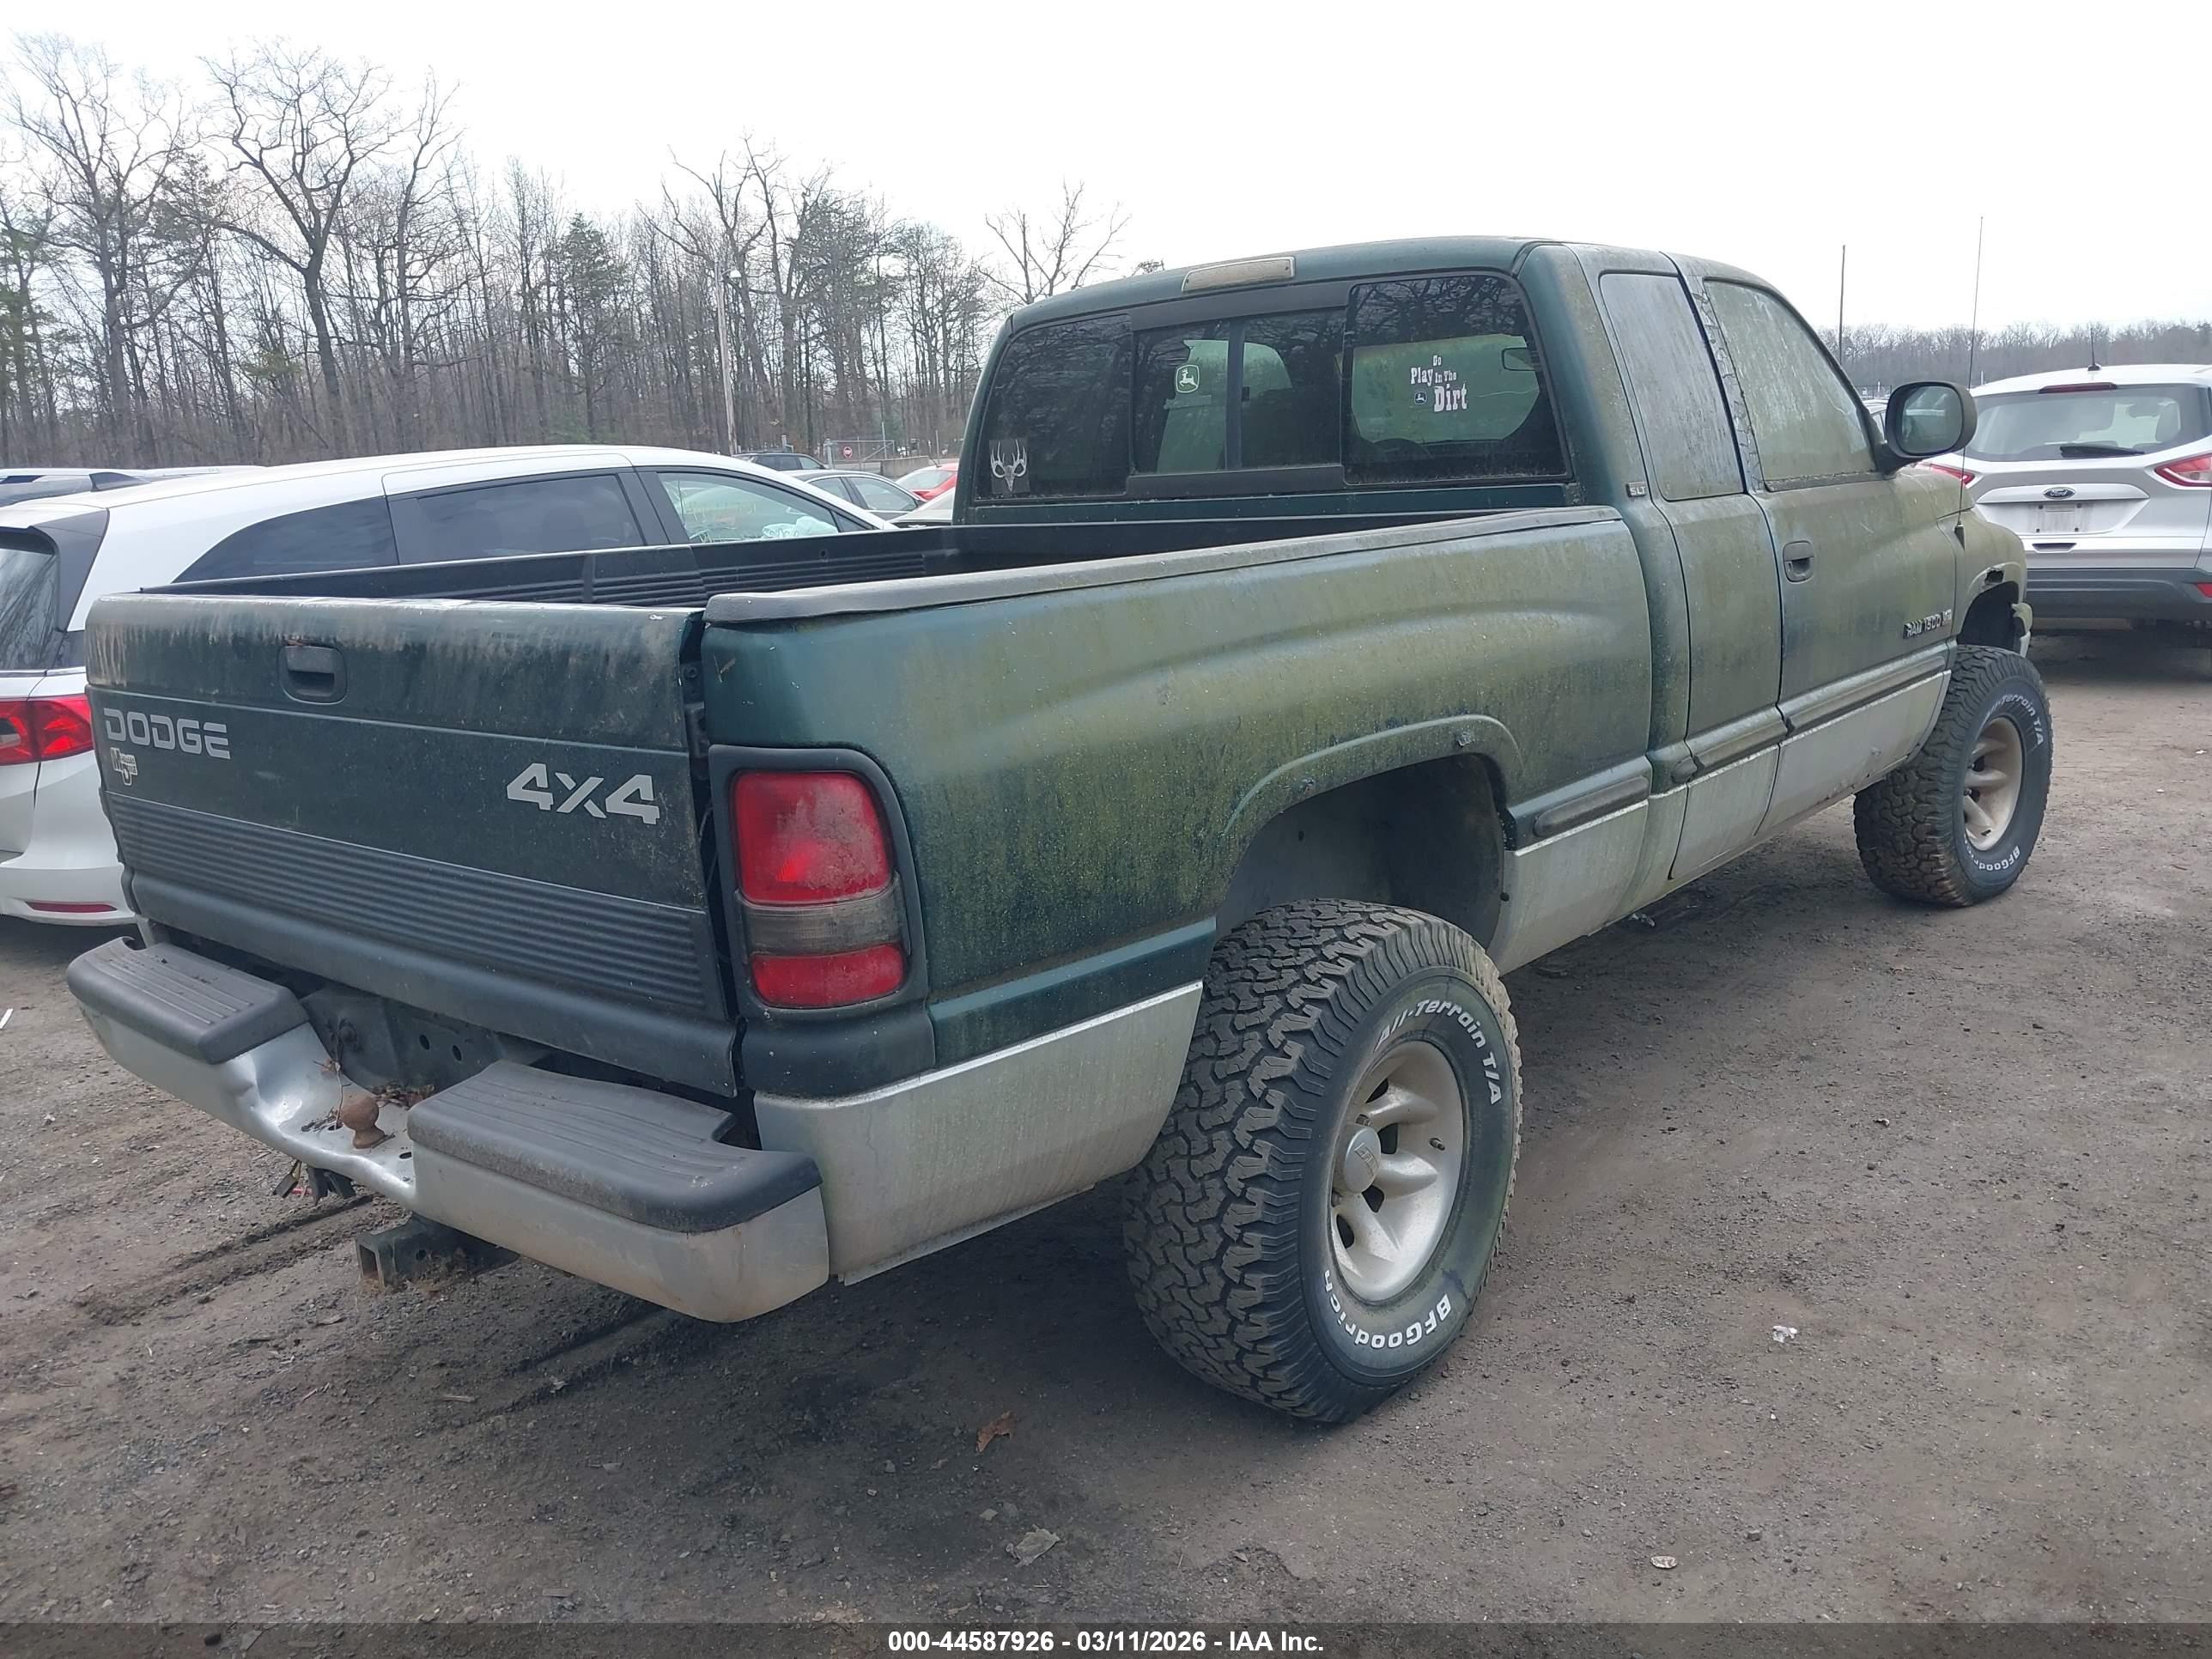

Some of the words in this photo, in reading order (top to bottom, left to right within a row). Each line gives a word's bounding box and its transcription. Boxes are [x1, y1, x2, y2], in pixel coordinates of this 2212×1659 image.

[1433, 355, 1442, 366] Go
[1411, 367, 1434, 386] Play
[1435, 372, 1443, 383] In
[1443, 370, 1457, 382] The
[1434, 383, 1468, 412] Dirt
[1630, 486, 1645, 495] SLT
[103, 708, 231, 760] DODGE
[2033, 717, 2044, 745] T/A
[1374, 999, 1486, 1052] All-Terrain
[1482, 1051, 1502, 1105] T/A
[1323, 1269, 1451, 1349] BFGoodrich
